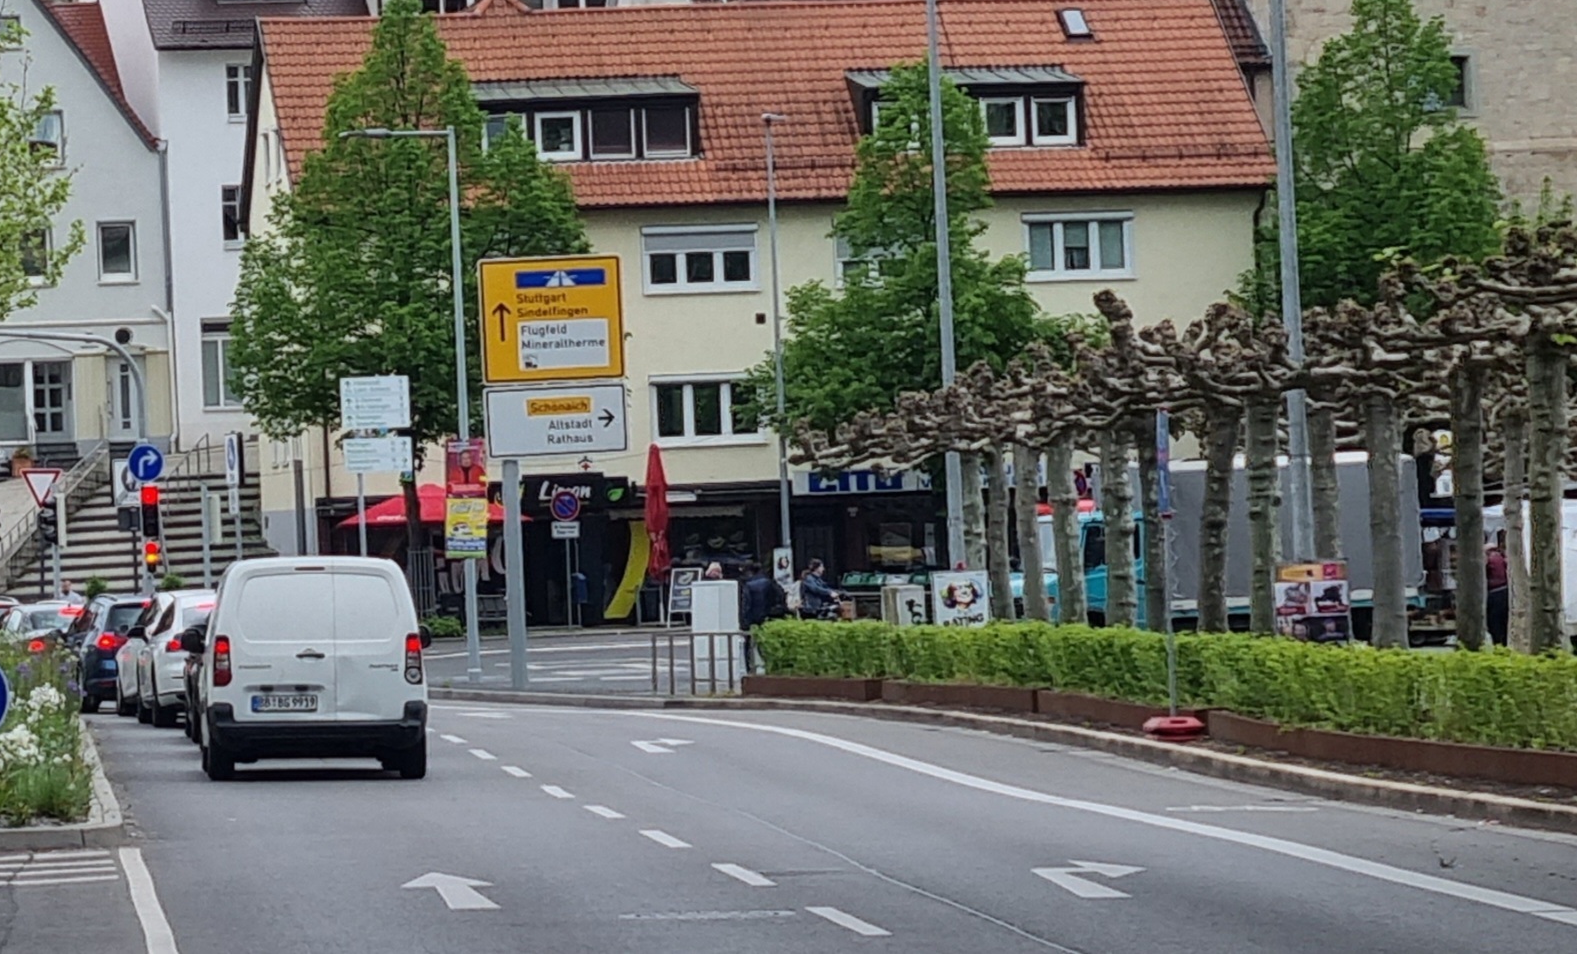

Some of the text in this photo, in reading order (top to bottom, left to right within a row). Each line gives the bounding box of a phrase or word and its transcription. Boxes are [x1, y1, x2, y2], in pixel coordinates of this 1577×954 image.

[516, 293, 566, 305] Stuttgart
[517, 306, 588, 317] Sindelfingen
[521, 325, 567, 337] Flugfeld
[522, 337, 605, 350] Mineraltherme
[548, 419, 593, 430] Altstadt
[547, 434, 593, 444] Rathaus
[292, 696, 316, 708] 9919
